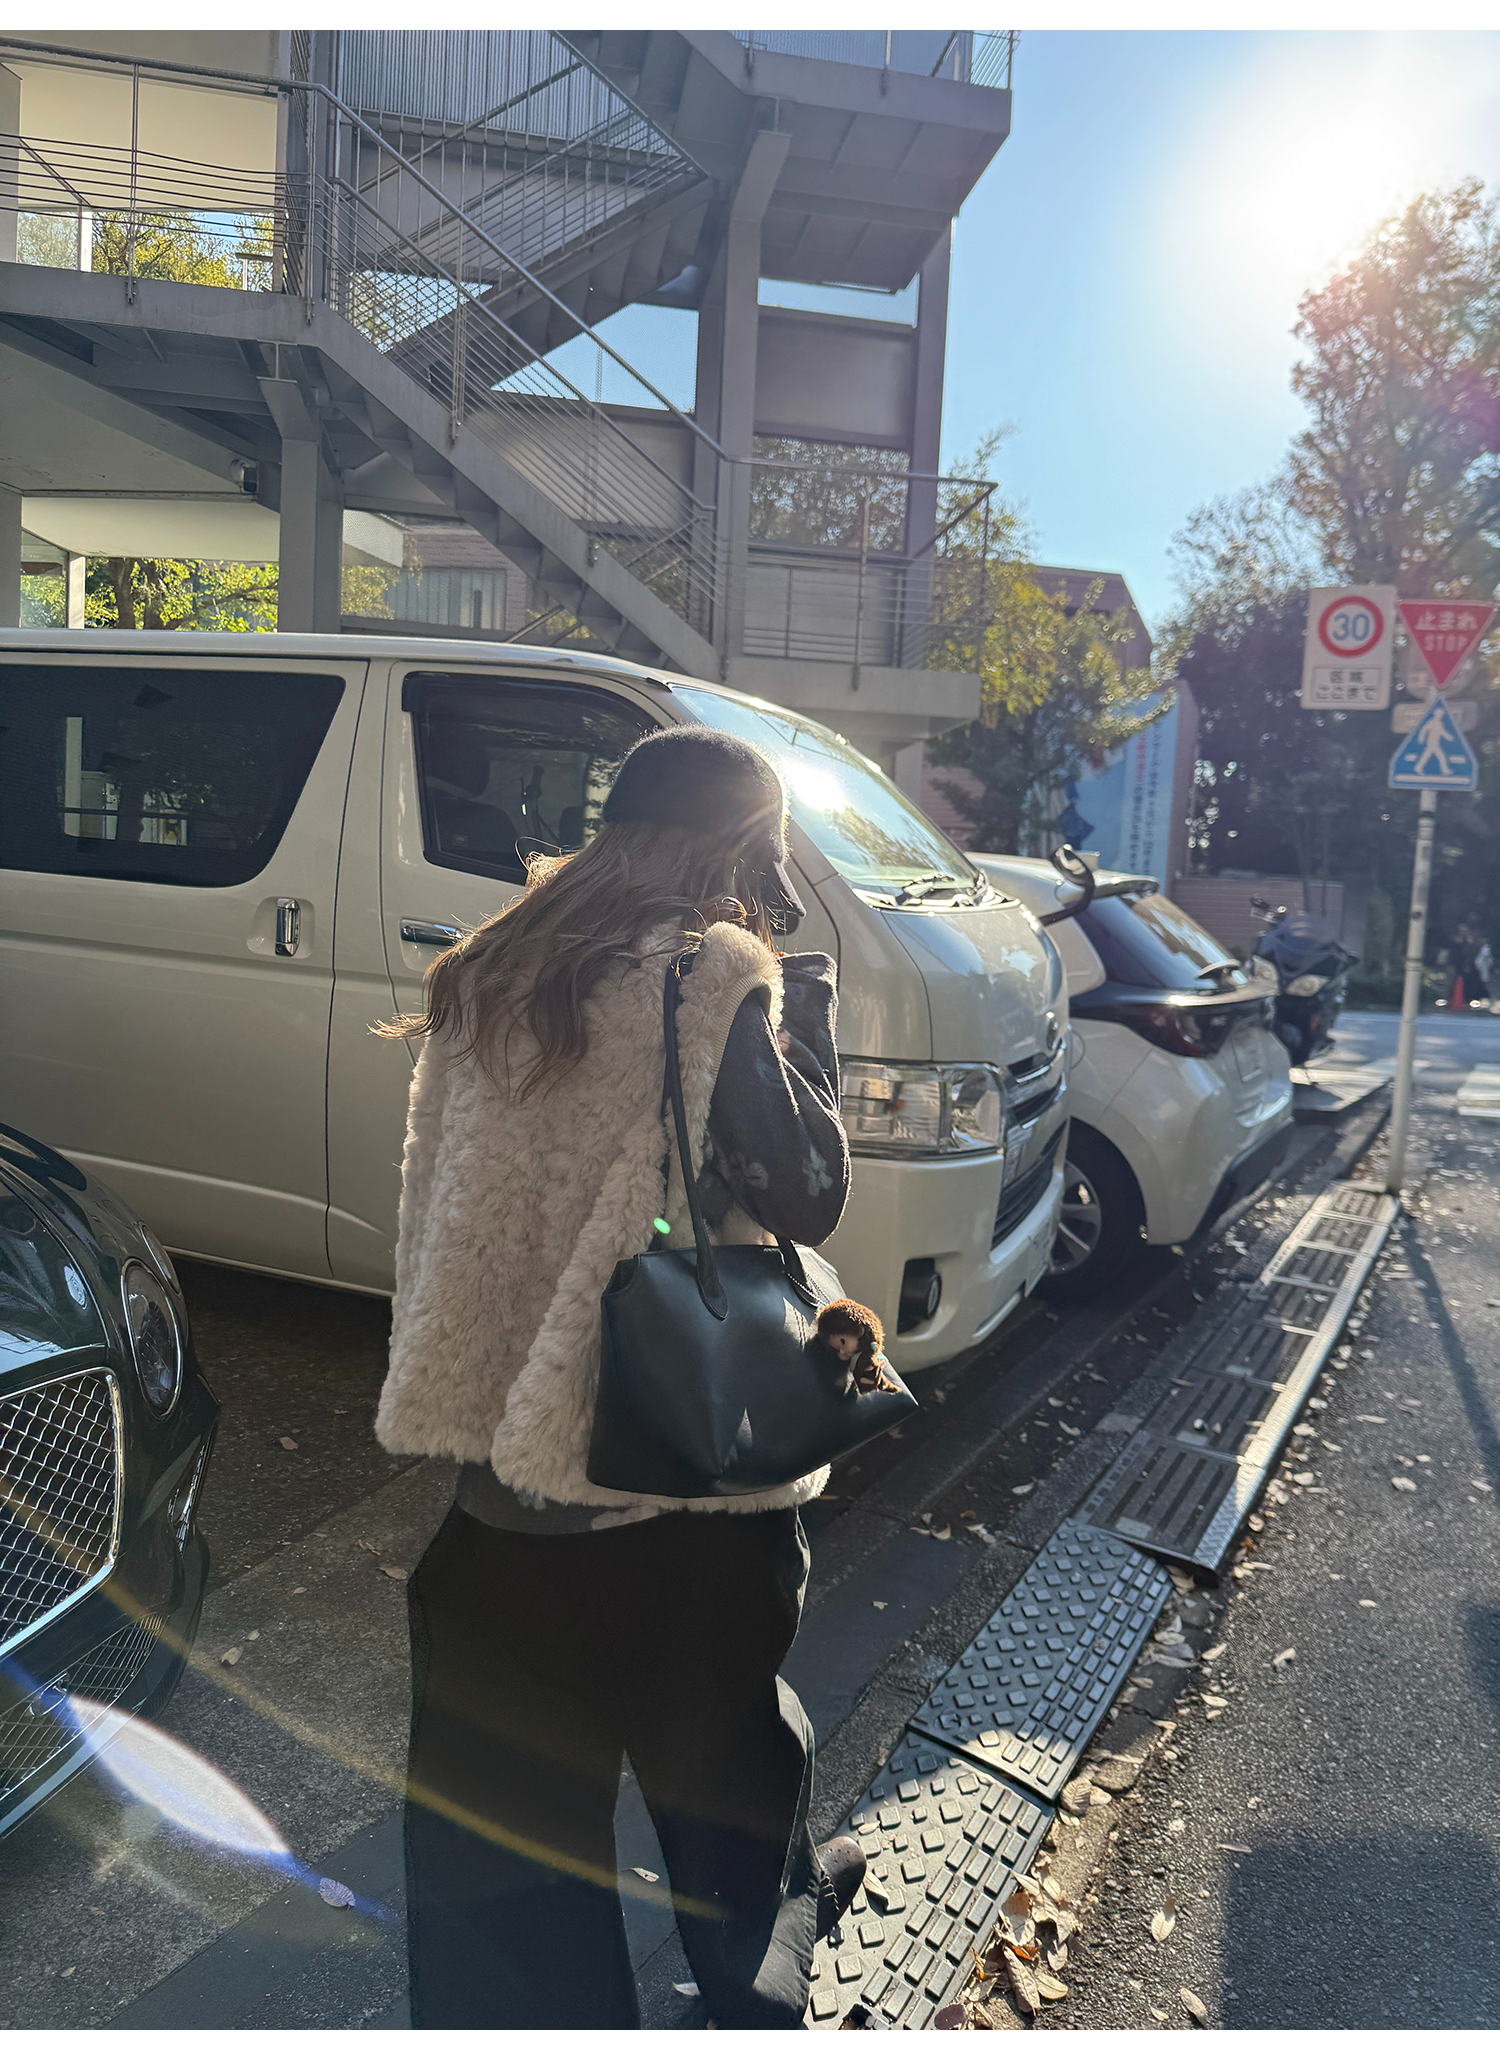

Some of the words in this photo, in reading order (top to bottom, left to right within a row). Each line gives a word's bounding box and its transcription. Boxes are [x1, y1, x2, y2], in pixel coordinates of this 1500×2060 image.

[1332, 613, 1370, 641] 30
[1416, 611, 1478, 631] 止まれ
[1425, 634, 1467, 651] STOP
[1330, 671, 1364, 684] 区域
[1316, 686, 1378, 700] ここまで
